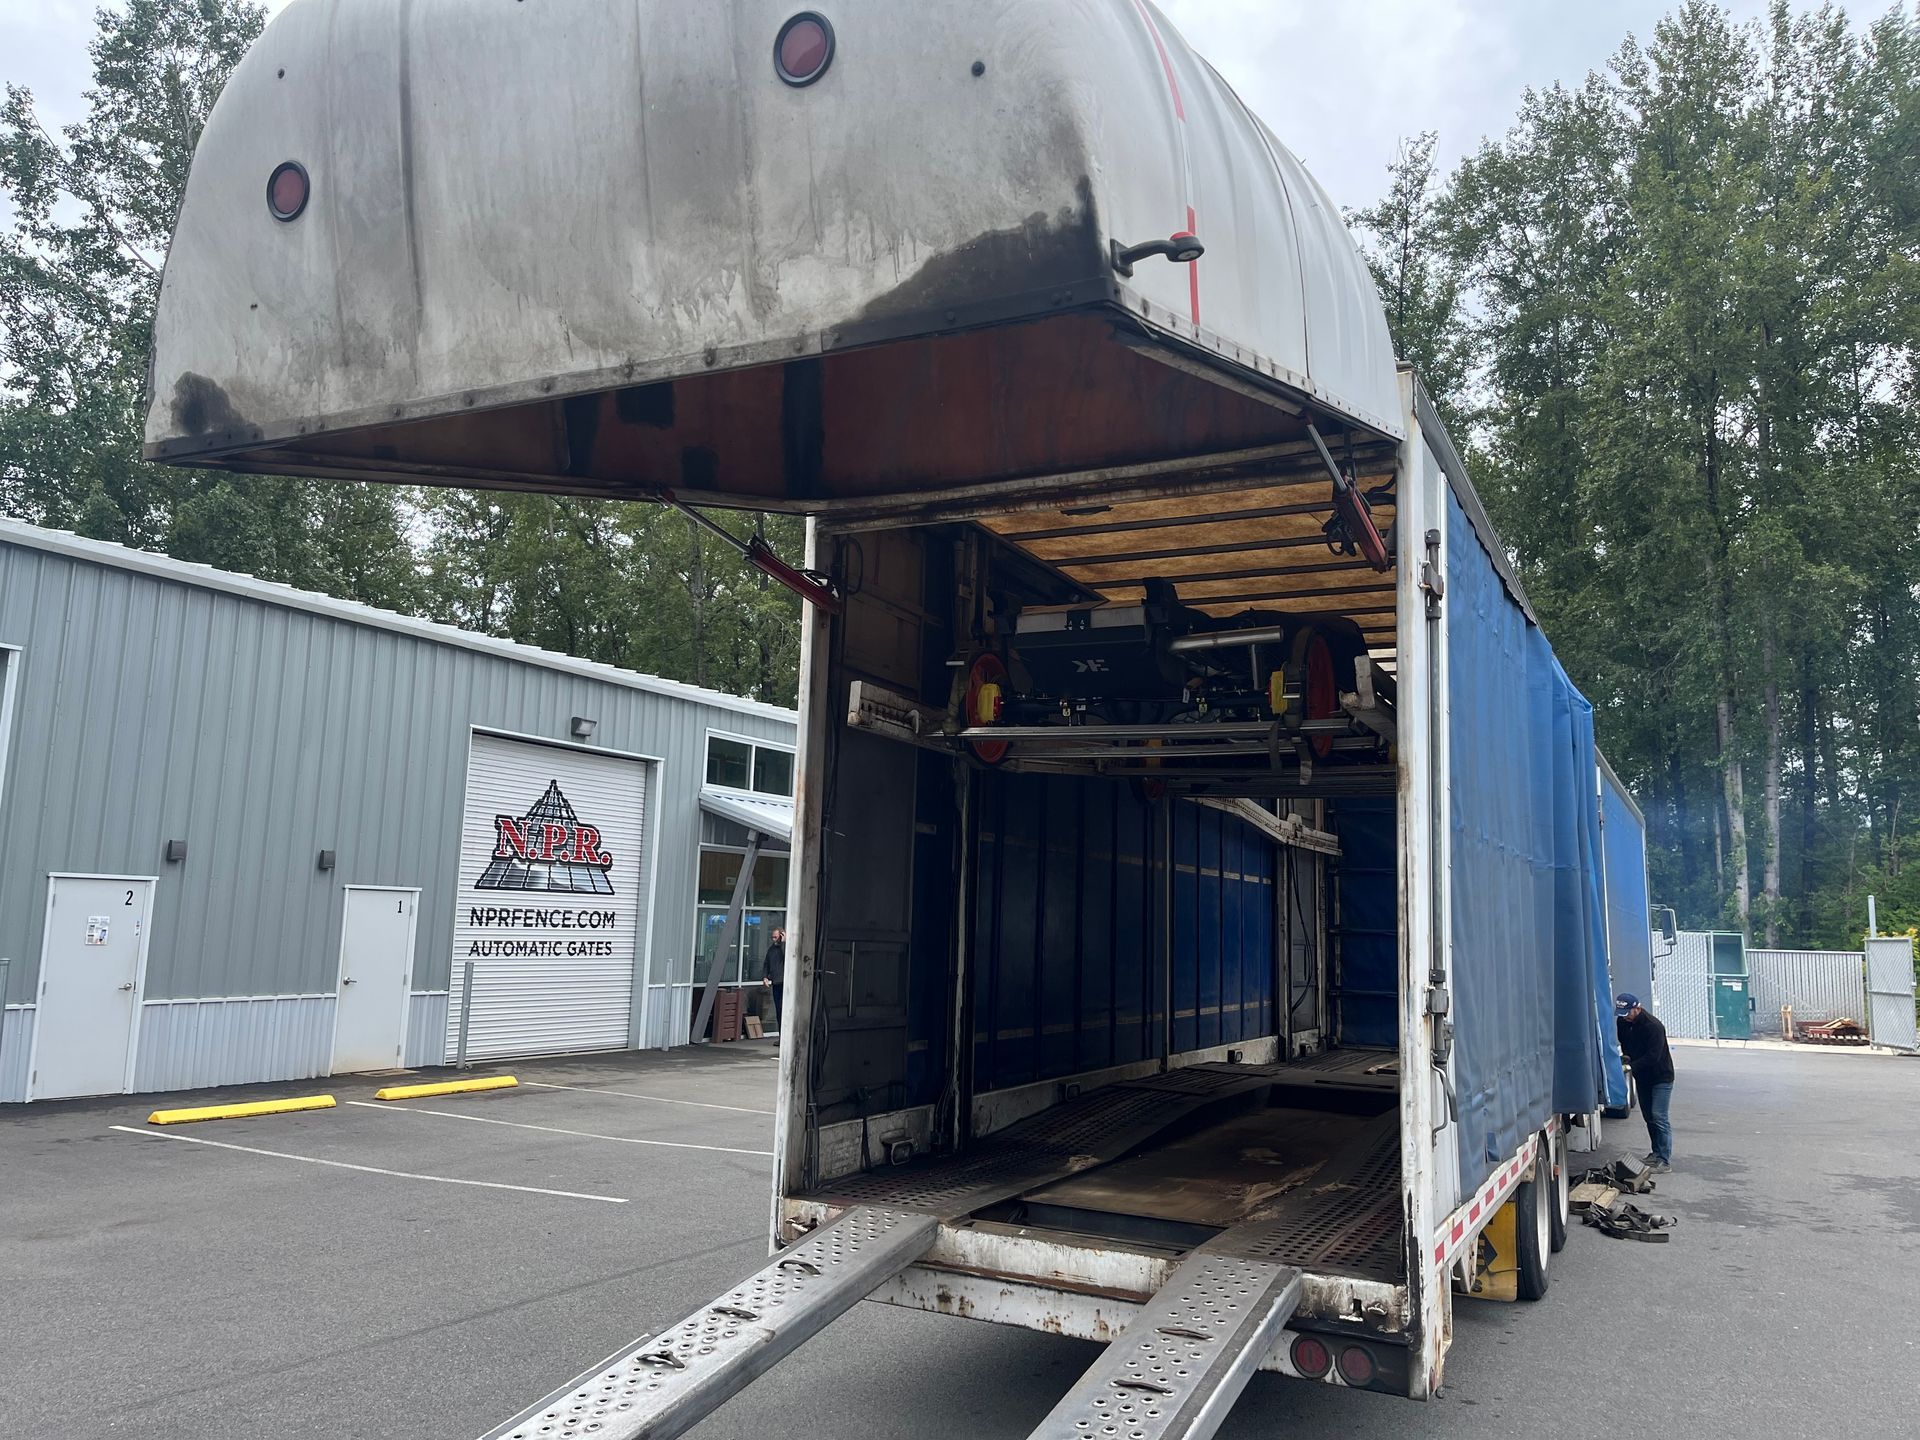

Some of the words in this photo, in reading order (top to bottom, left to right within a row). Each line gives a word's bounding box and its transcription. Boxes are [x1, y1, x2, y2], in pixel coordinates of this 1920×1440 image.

[495, 818, 611, 864] N.P.R.
[125, 890, 134, 905] 2
[397, 900, 402, 913] 1
[469, 906, 616, 928] NPRFENCE.COM
[468, 940, 562, 956] AUTOMATIC
[566, 941, 612, 956] GATES
